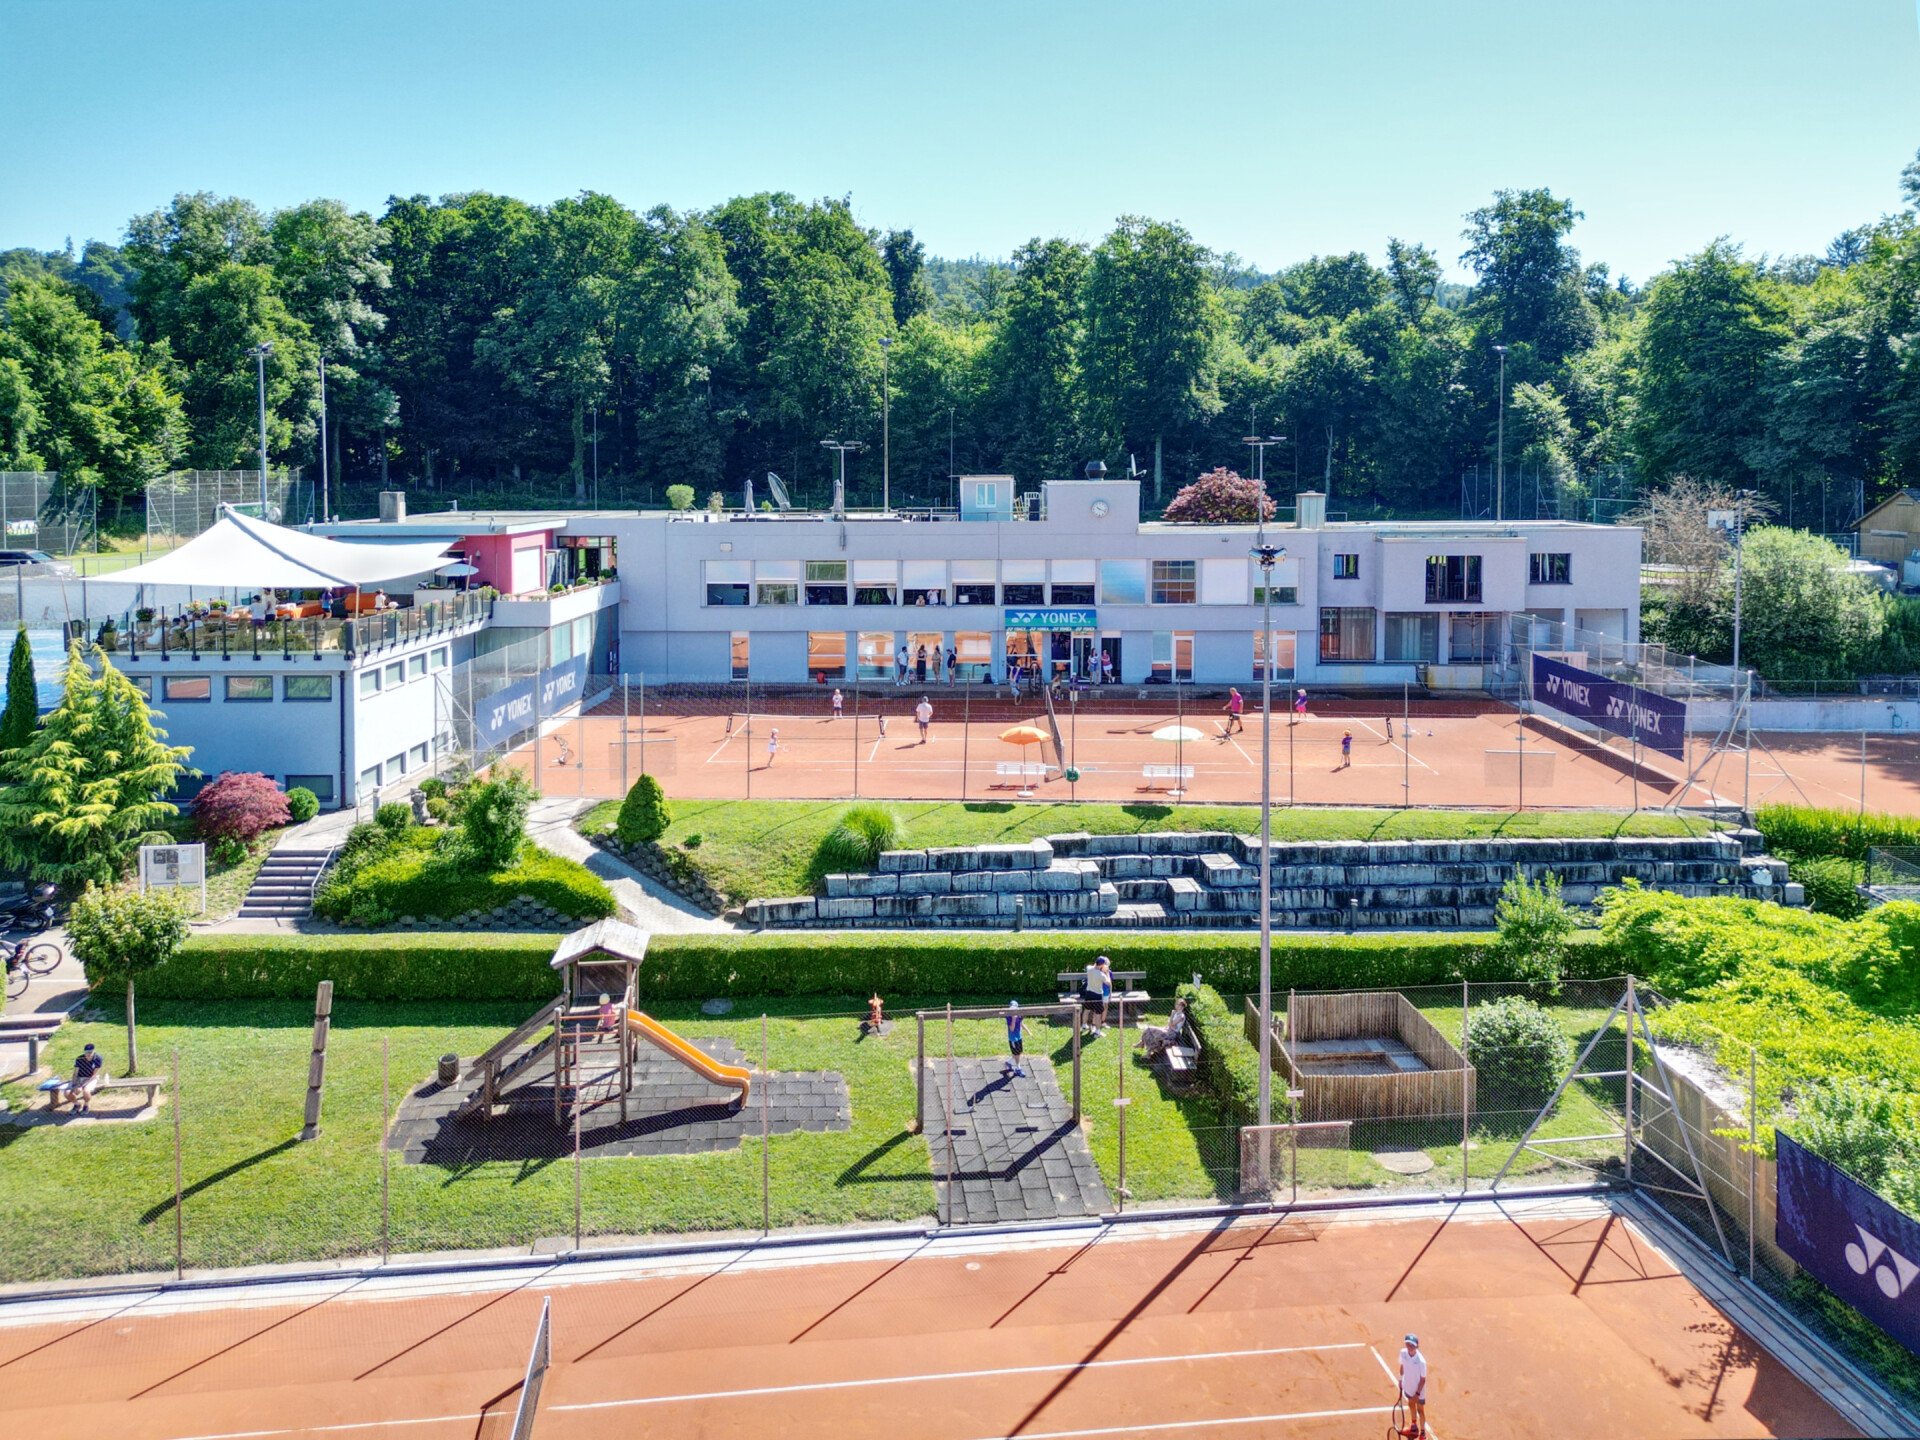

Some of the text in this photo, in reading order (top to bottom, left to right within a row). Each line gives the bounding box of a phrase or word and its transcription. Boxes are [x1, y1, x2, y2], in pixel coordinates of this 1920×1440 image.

[1040, 612, 1087, 624] YONEX
[555, 671, 576, 697] YONEX
[1562, 678, 1590, 707] YONEX
[507, 693, 532, 722] YONEX
[1626, 701, 1661, 734] YONEX
